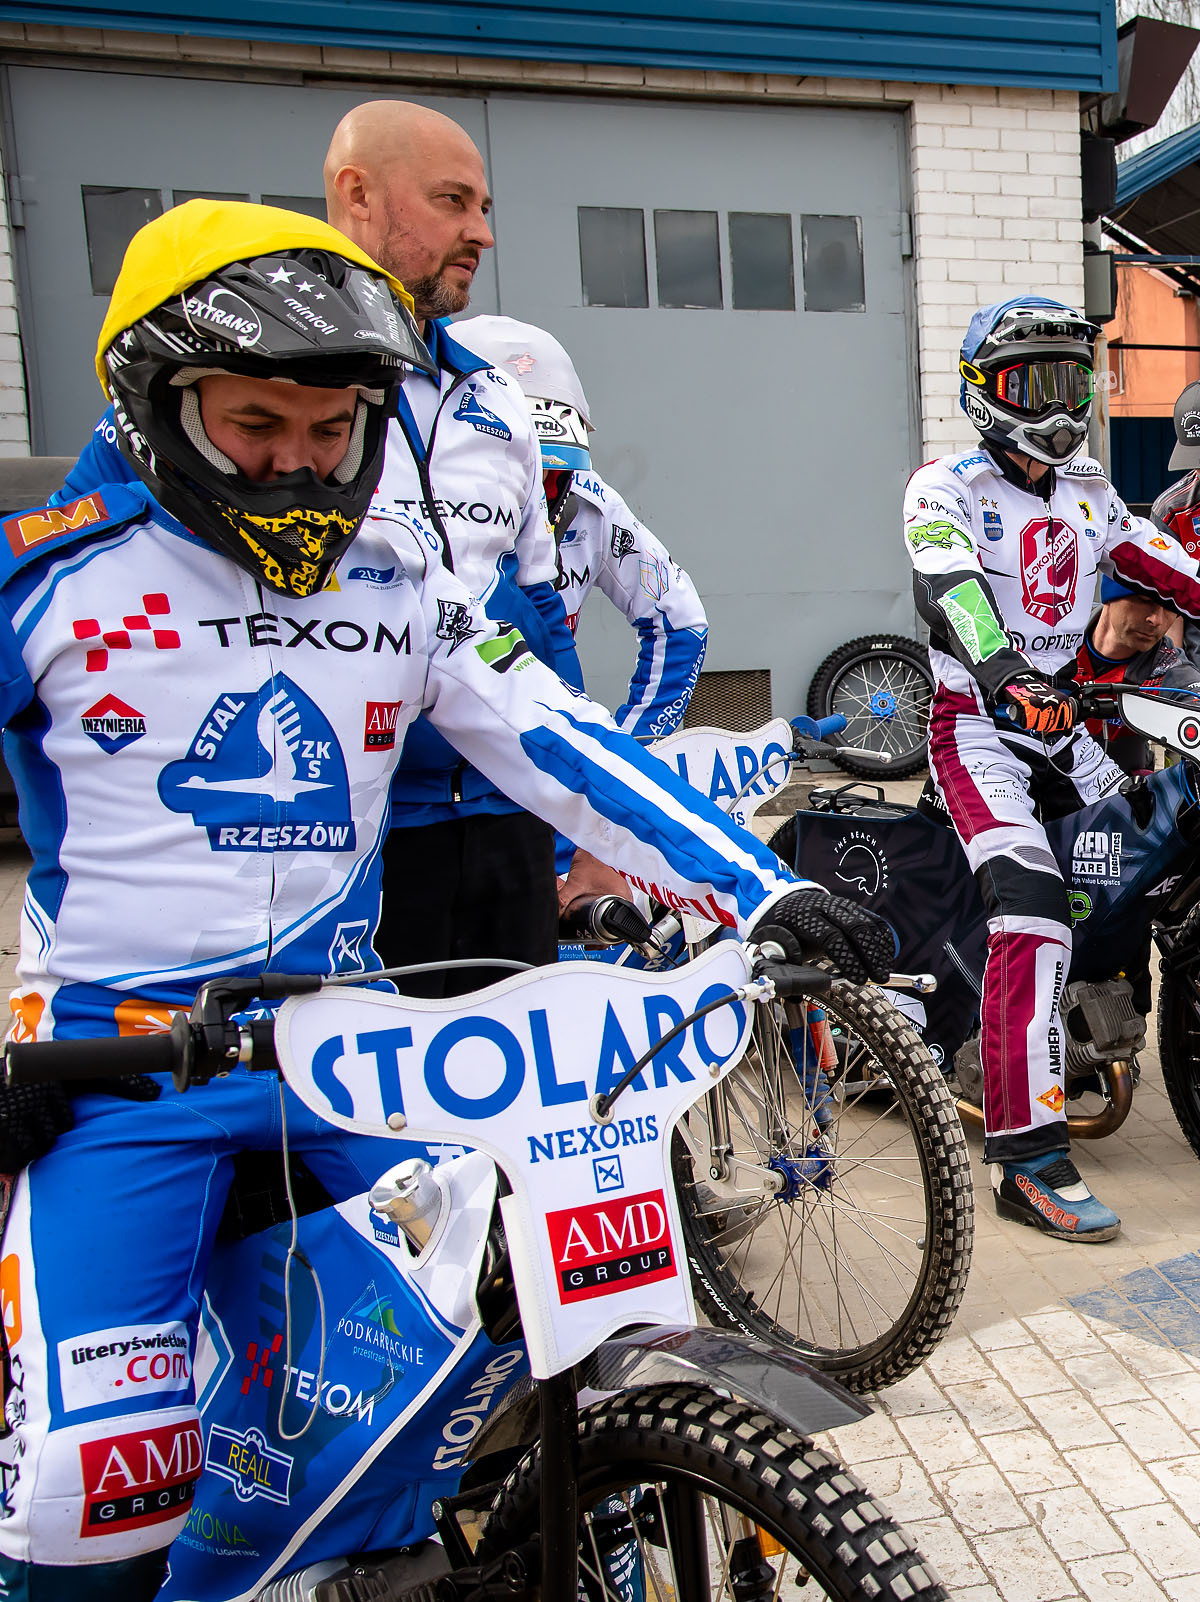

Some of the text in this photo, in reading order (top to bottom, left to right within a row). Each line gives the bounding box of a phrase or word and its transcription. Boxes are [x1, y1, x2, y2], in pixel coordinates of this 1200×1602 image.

[184, 298, 258, 334] EXTRANS
[283, 297, 339, 335] minioli
[534, 420, 560, 432] rai
[394, 499, 516, 530] TEXOM
[198, 611, 411, 656] TEXOM
[1016, 674, 1059, 705] FOX
[194, 696, 246, 761] STAL
[301, 740, 331, 760] ZK
[218, 822, 350, 848] RZESZÓW
[1073, 831, 1109, 859] RED
[833, 832, 889, 889] THE BEACH BREAK
[1096, 878, 1120, 887] Logistics
[311, 983, 747, 1121] STOLARO
[1047, 1027, 1062, 1077] AMBER
[527, 1114, 659, 1165] NEXORIS
[1014, 1172, 1080, 1231] daytona
[561, 1200, 666, 1262] AMD
[569, 1250, 668, 1286] GROUP
[337, 1318, 424, 1366] PODKARPACKIE
[114, 1352, 189, 1388] .com
[283, 1363, 375, 1427] TEXOM
[432, 1350, 524, 1471] STOLARO
[92, 1429, 203, 1496] AMD
[228, 1443, 272, 1487] REALL
[215, 1547, 261, 1558] LIGHTING
